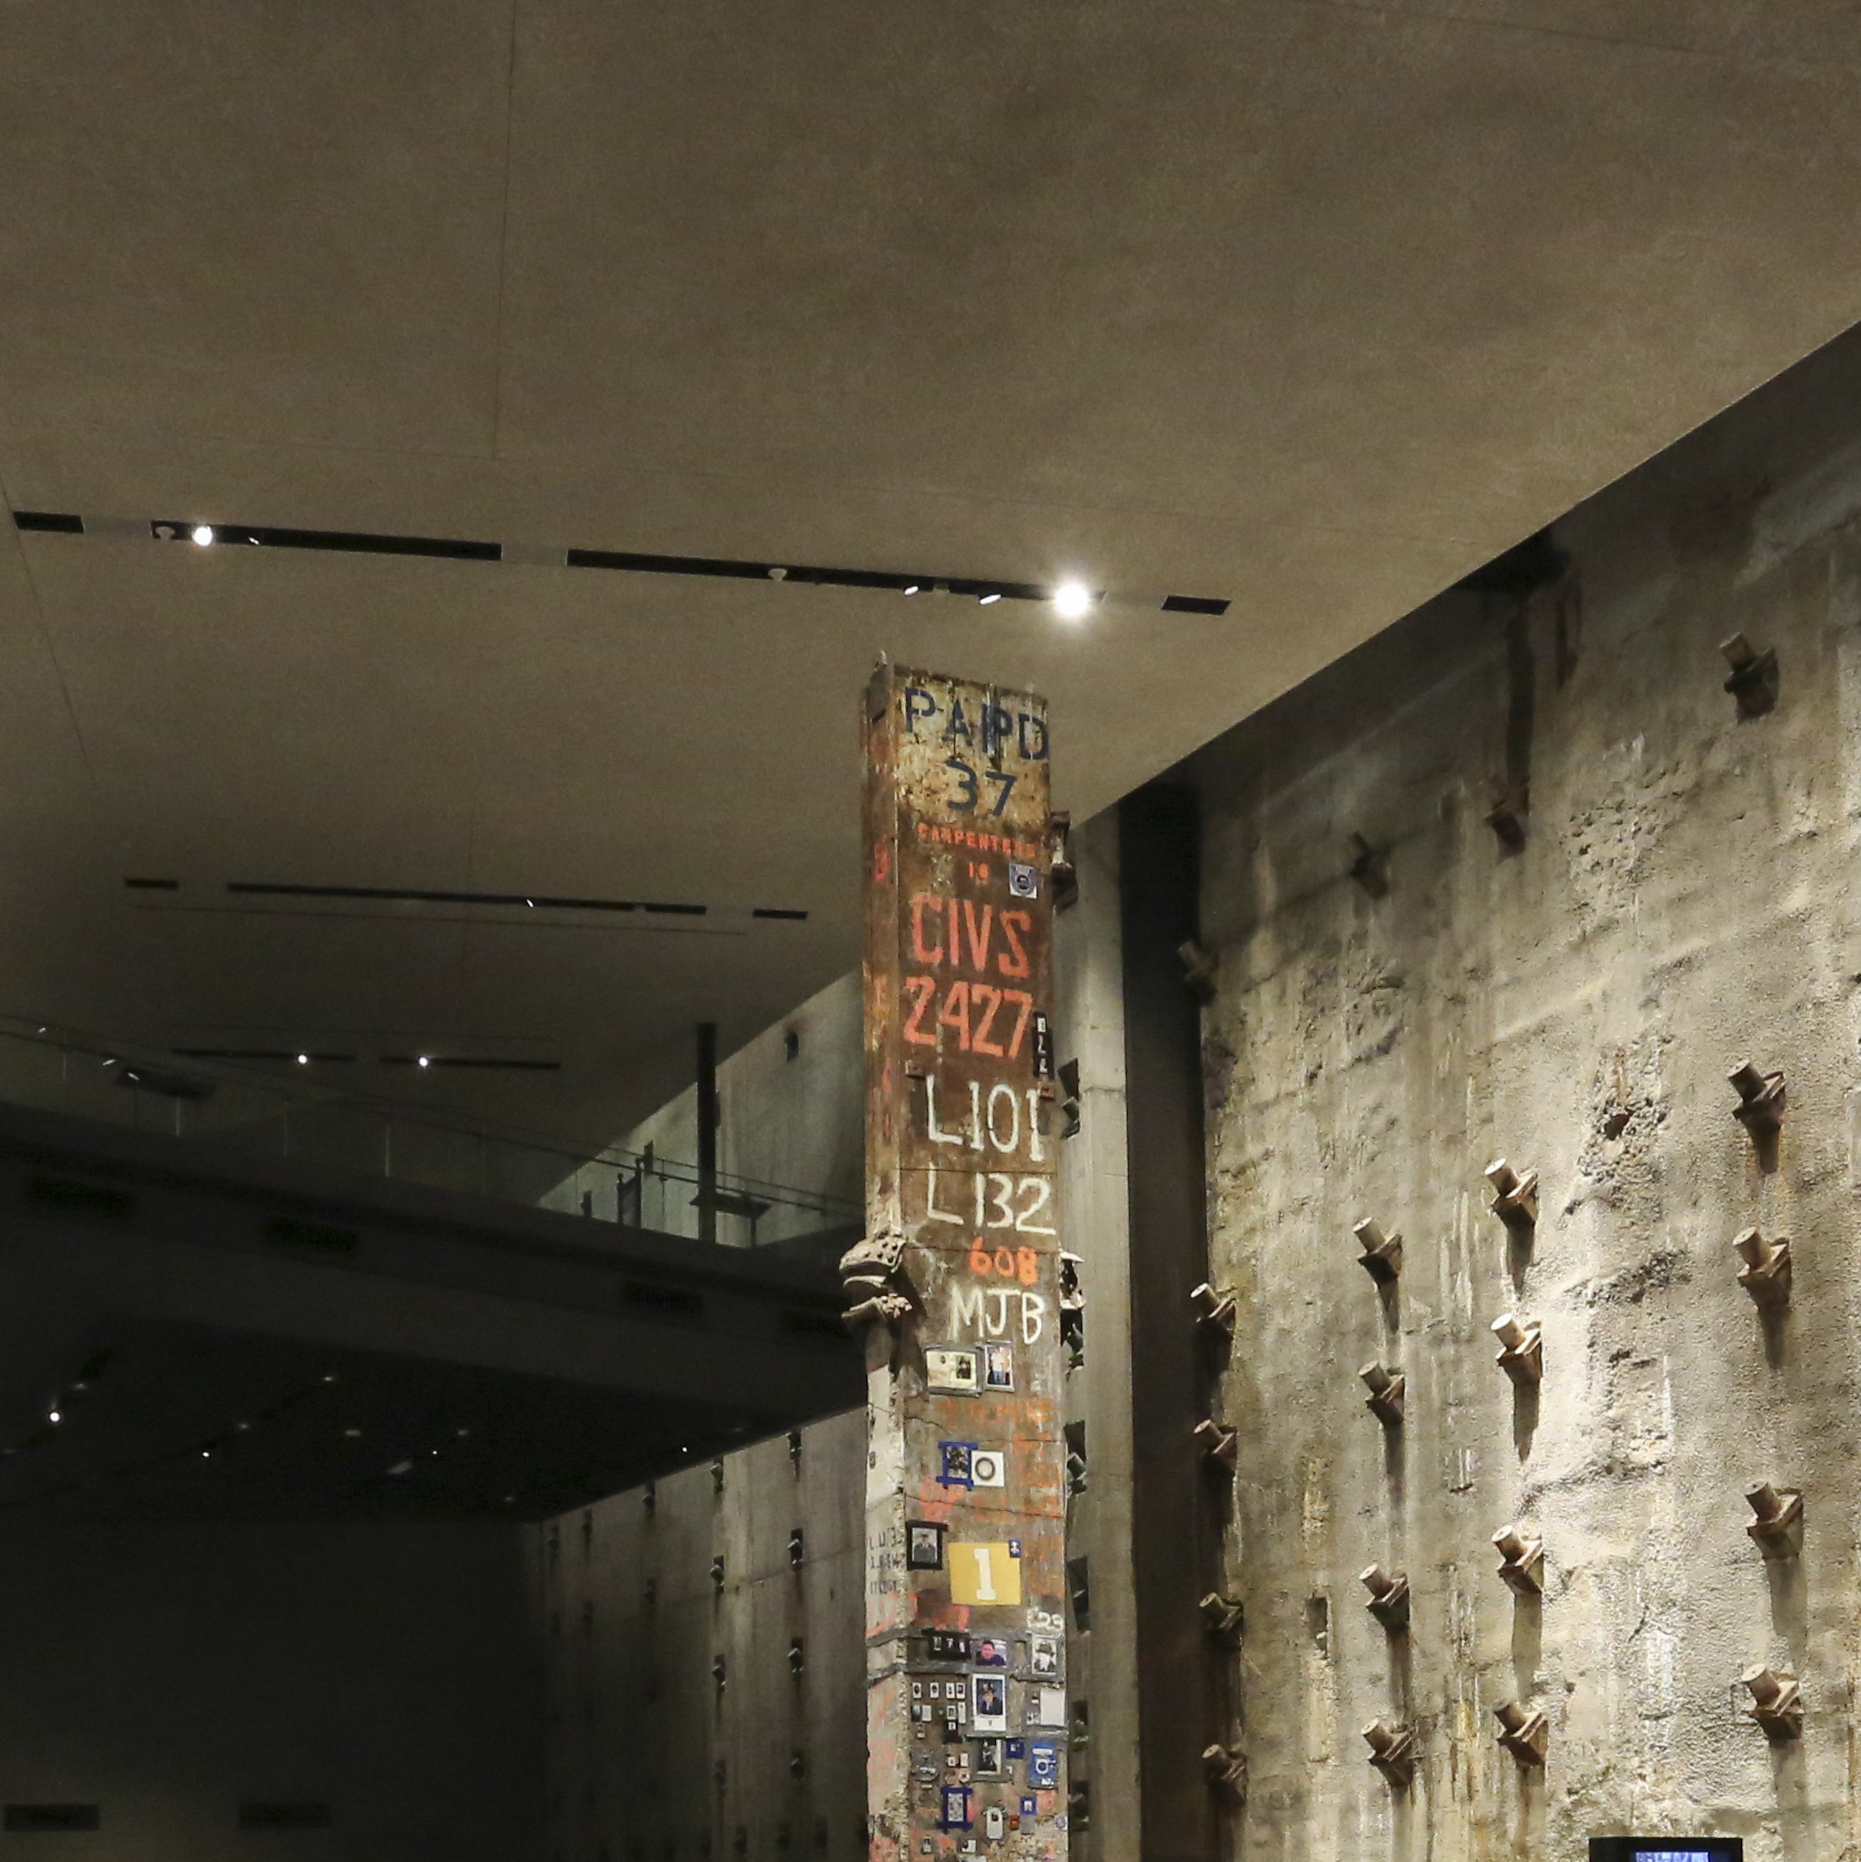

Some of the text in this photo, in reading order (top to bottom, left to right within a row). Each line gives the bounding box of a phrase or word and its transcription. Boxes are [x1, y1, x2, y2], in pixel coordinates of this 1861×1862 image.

[904, 687, 1049, 760] PAPD
[946, 759, 1018, 818] 37
[911, 892, 1031, 978] CIVS
[903, 975, 1033, 1060] 2427
[925, 1073, 1044, 1162] L101
[927, 1162, 1057, 1236] L132
[968, 1236, 1039, 1286] 608
[947, 1283, 1045, 1345] MJB
[973, 1547, 997, 1600] 1
